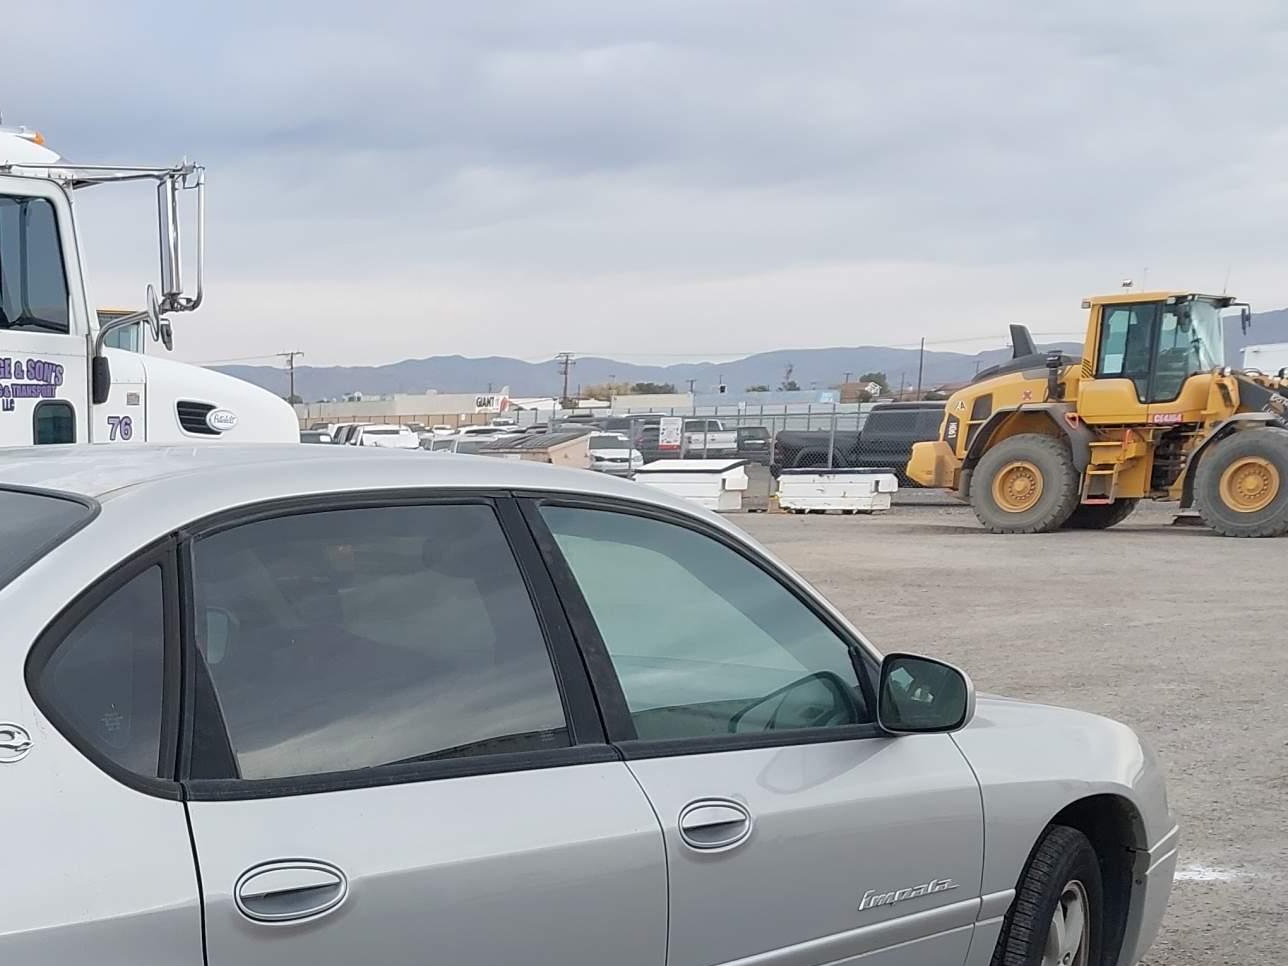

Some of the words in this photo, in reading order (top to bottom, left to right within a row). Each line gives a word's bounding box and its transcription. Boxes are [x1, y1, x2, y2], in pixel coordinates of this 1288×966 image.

[14, 361, 25, 379] &
[26, 358, 64, 386] SON'S
[3, 385, 11, 398] &
[11, 383, 57, 398] TRANSPORT
[2, 399, 15, 411] LLC
[476, 396, 495, 408] GIANT
[107, 416, 133, 441] 76
[858, 878, 961, 911] Impala
